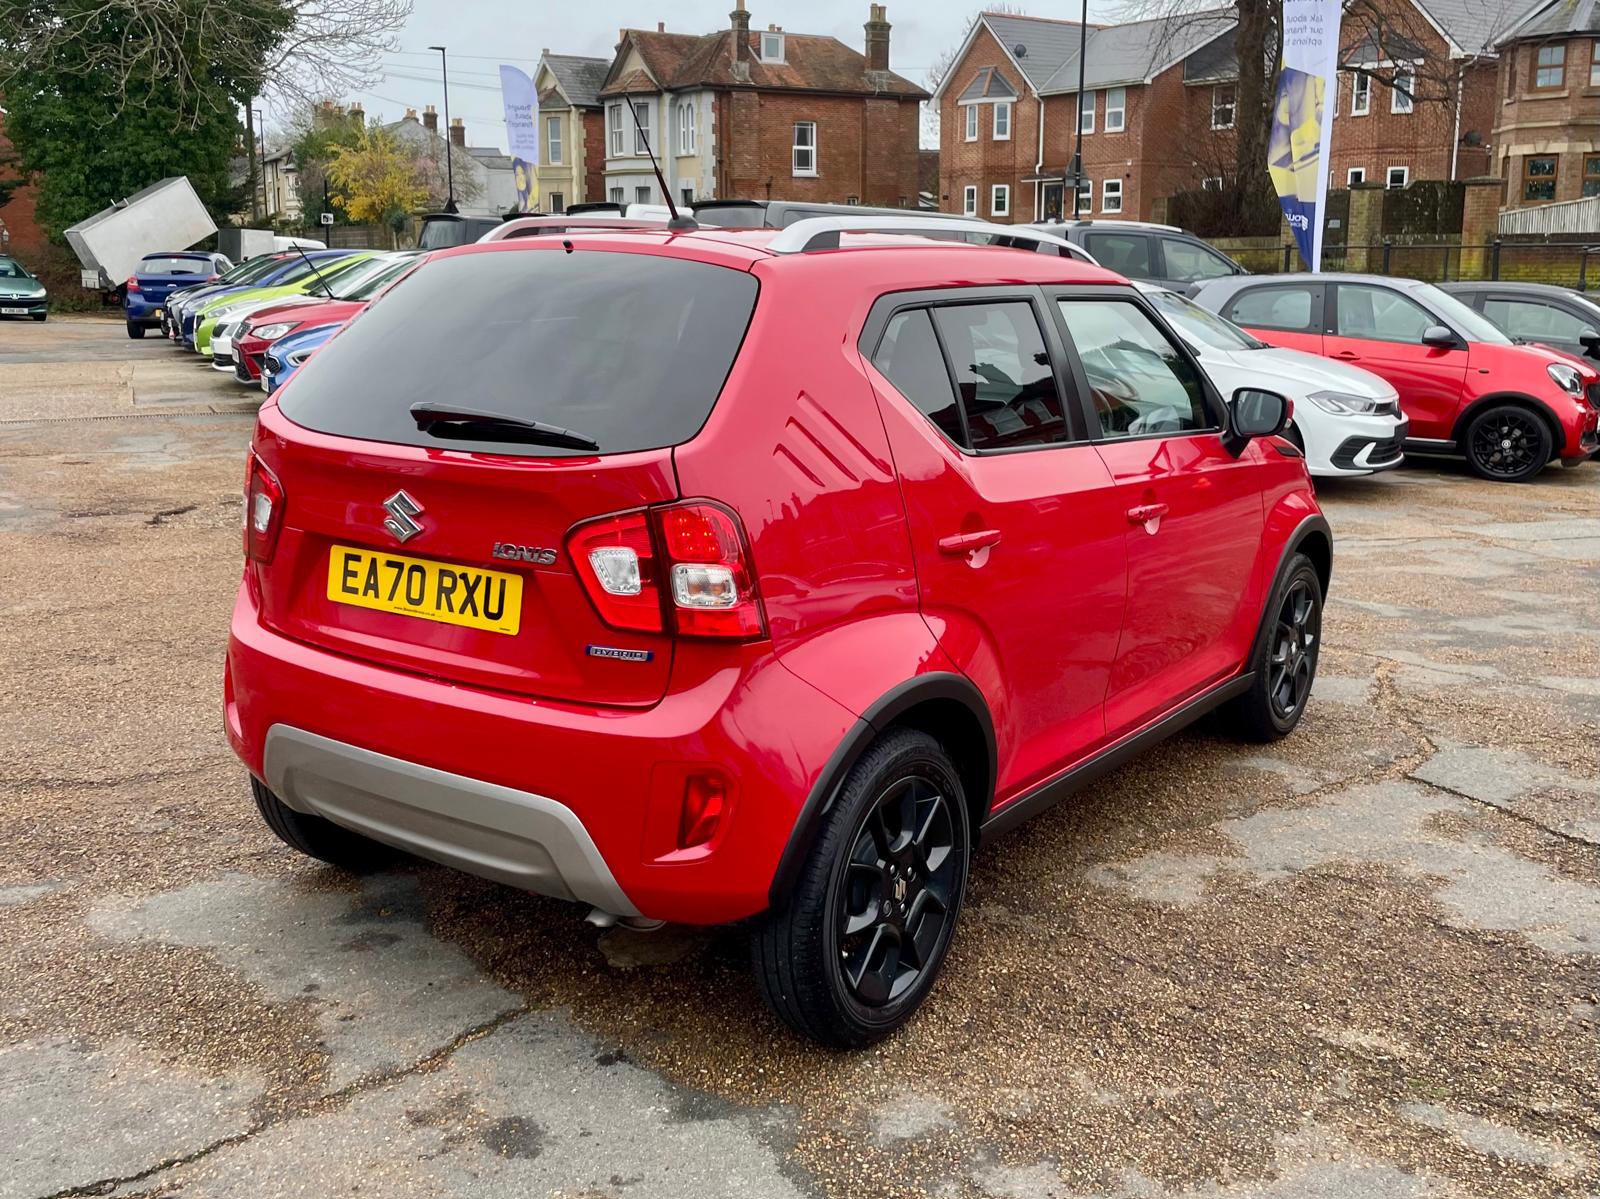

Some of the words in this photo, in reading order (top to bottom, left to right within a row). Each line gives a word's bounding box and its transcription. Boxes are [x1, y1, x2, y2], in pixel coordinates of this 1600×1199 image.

[492, 541, 558, 565] IGNIS
[341, 553, 426, 607] EA70
[435, 569, 507, 621] RXU
[594, 648, 643, 659] HYBRID
